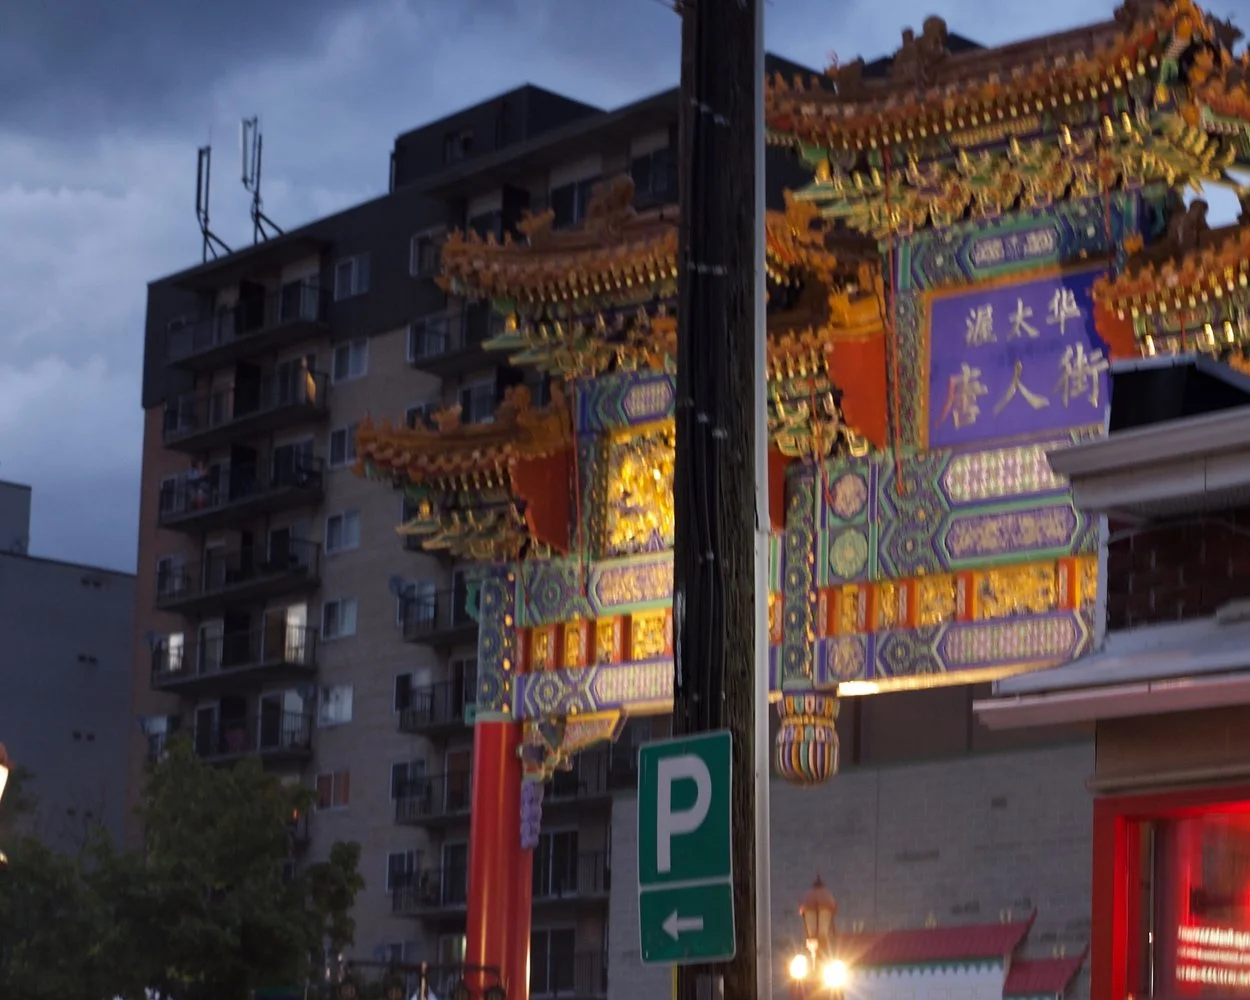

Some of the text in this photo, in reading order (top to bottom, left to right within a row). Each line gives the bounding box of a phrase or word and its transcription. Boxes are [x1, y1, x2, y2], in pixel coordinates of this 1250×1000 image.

[934, 341, 1109, 431] 唐人街
[656, 753, 712, 873] P
